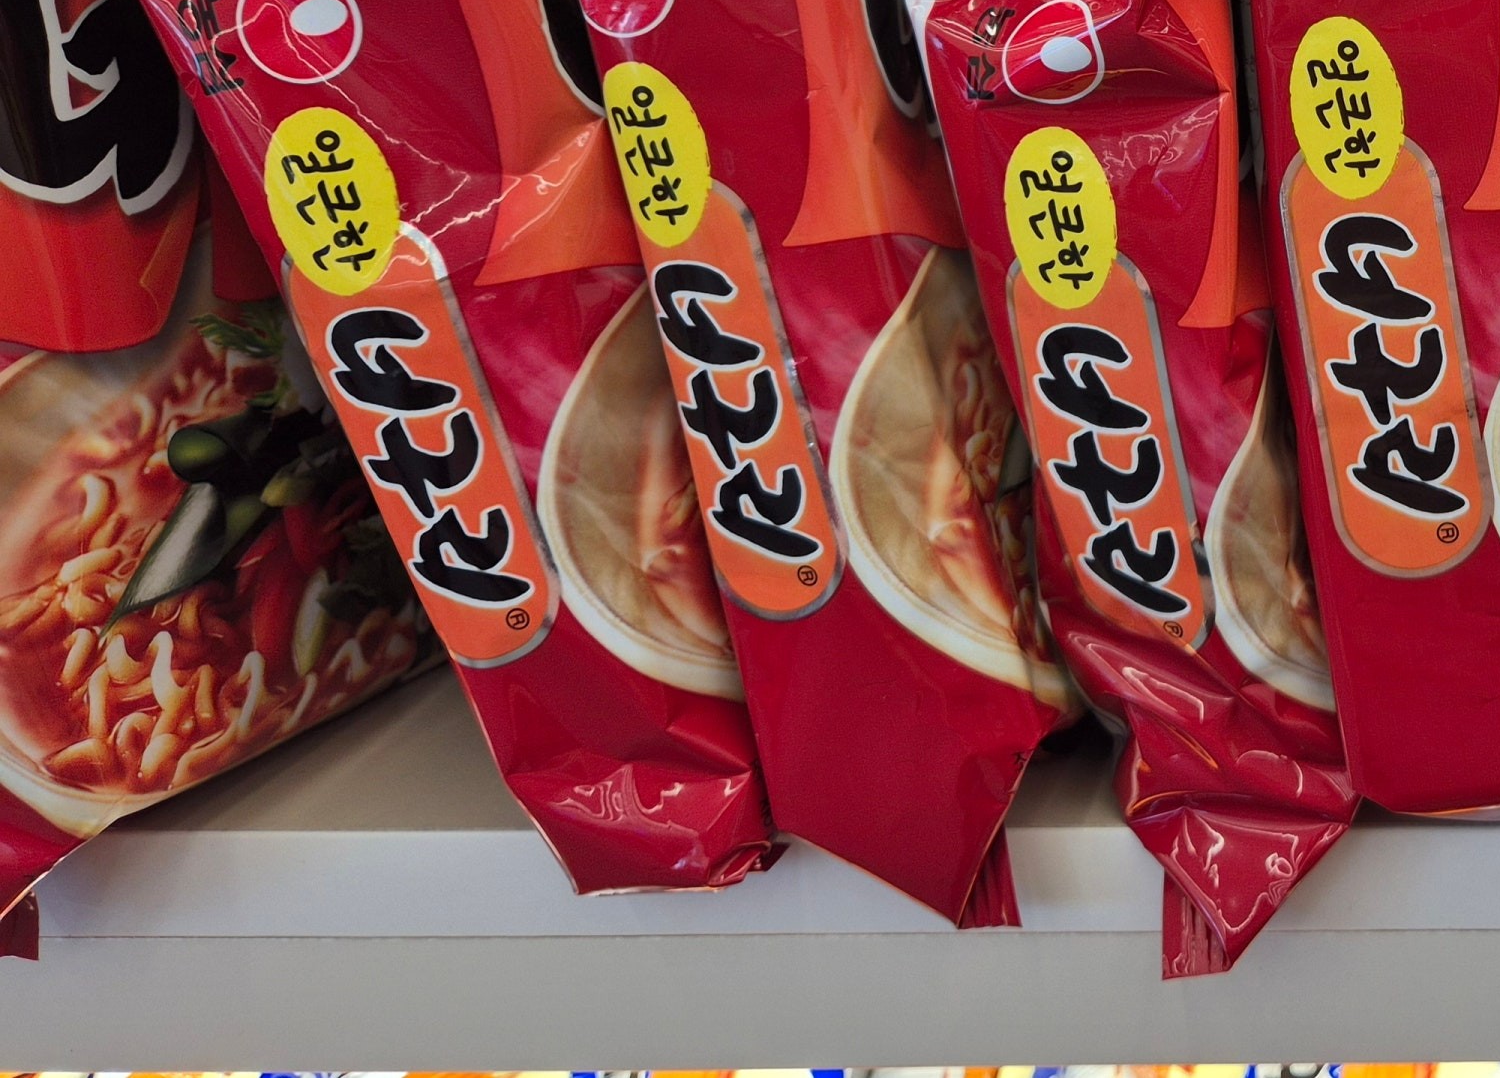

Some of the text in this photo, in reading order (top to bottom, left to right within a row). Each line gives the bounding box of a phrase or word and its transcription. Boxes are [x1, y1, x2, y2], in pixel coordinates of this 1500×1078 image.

[281, 129, 377, 273] 얼큰한
[611, 86, 689, 226] 얼큰한
[1307, 38, 1381, 178] 얼큰한
[1021, 150, 1095, 290] 얼큰한
[327, 306, 535, 606] 너구리
[652, 260, 823, 562] 너구리
[1035, 322, 1190, 620] 너구리
[1313, 215, 1467, 520] 너구리
